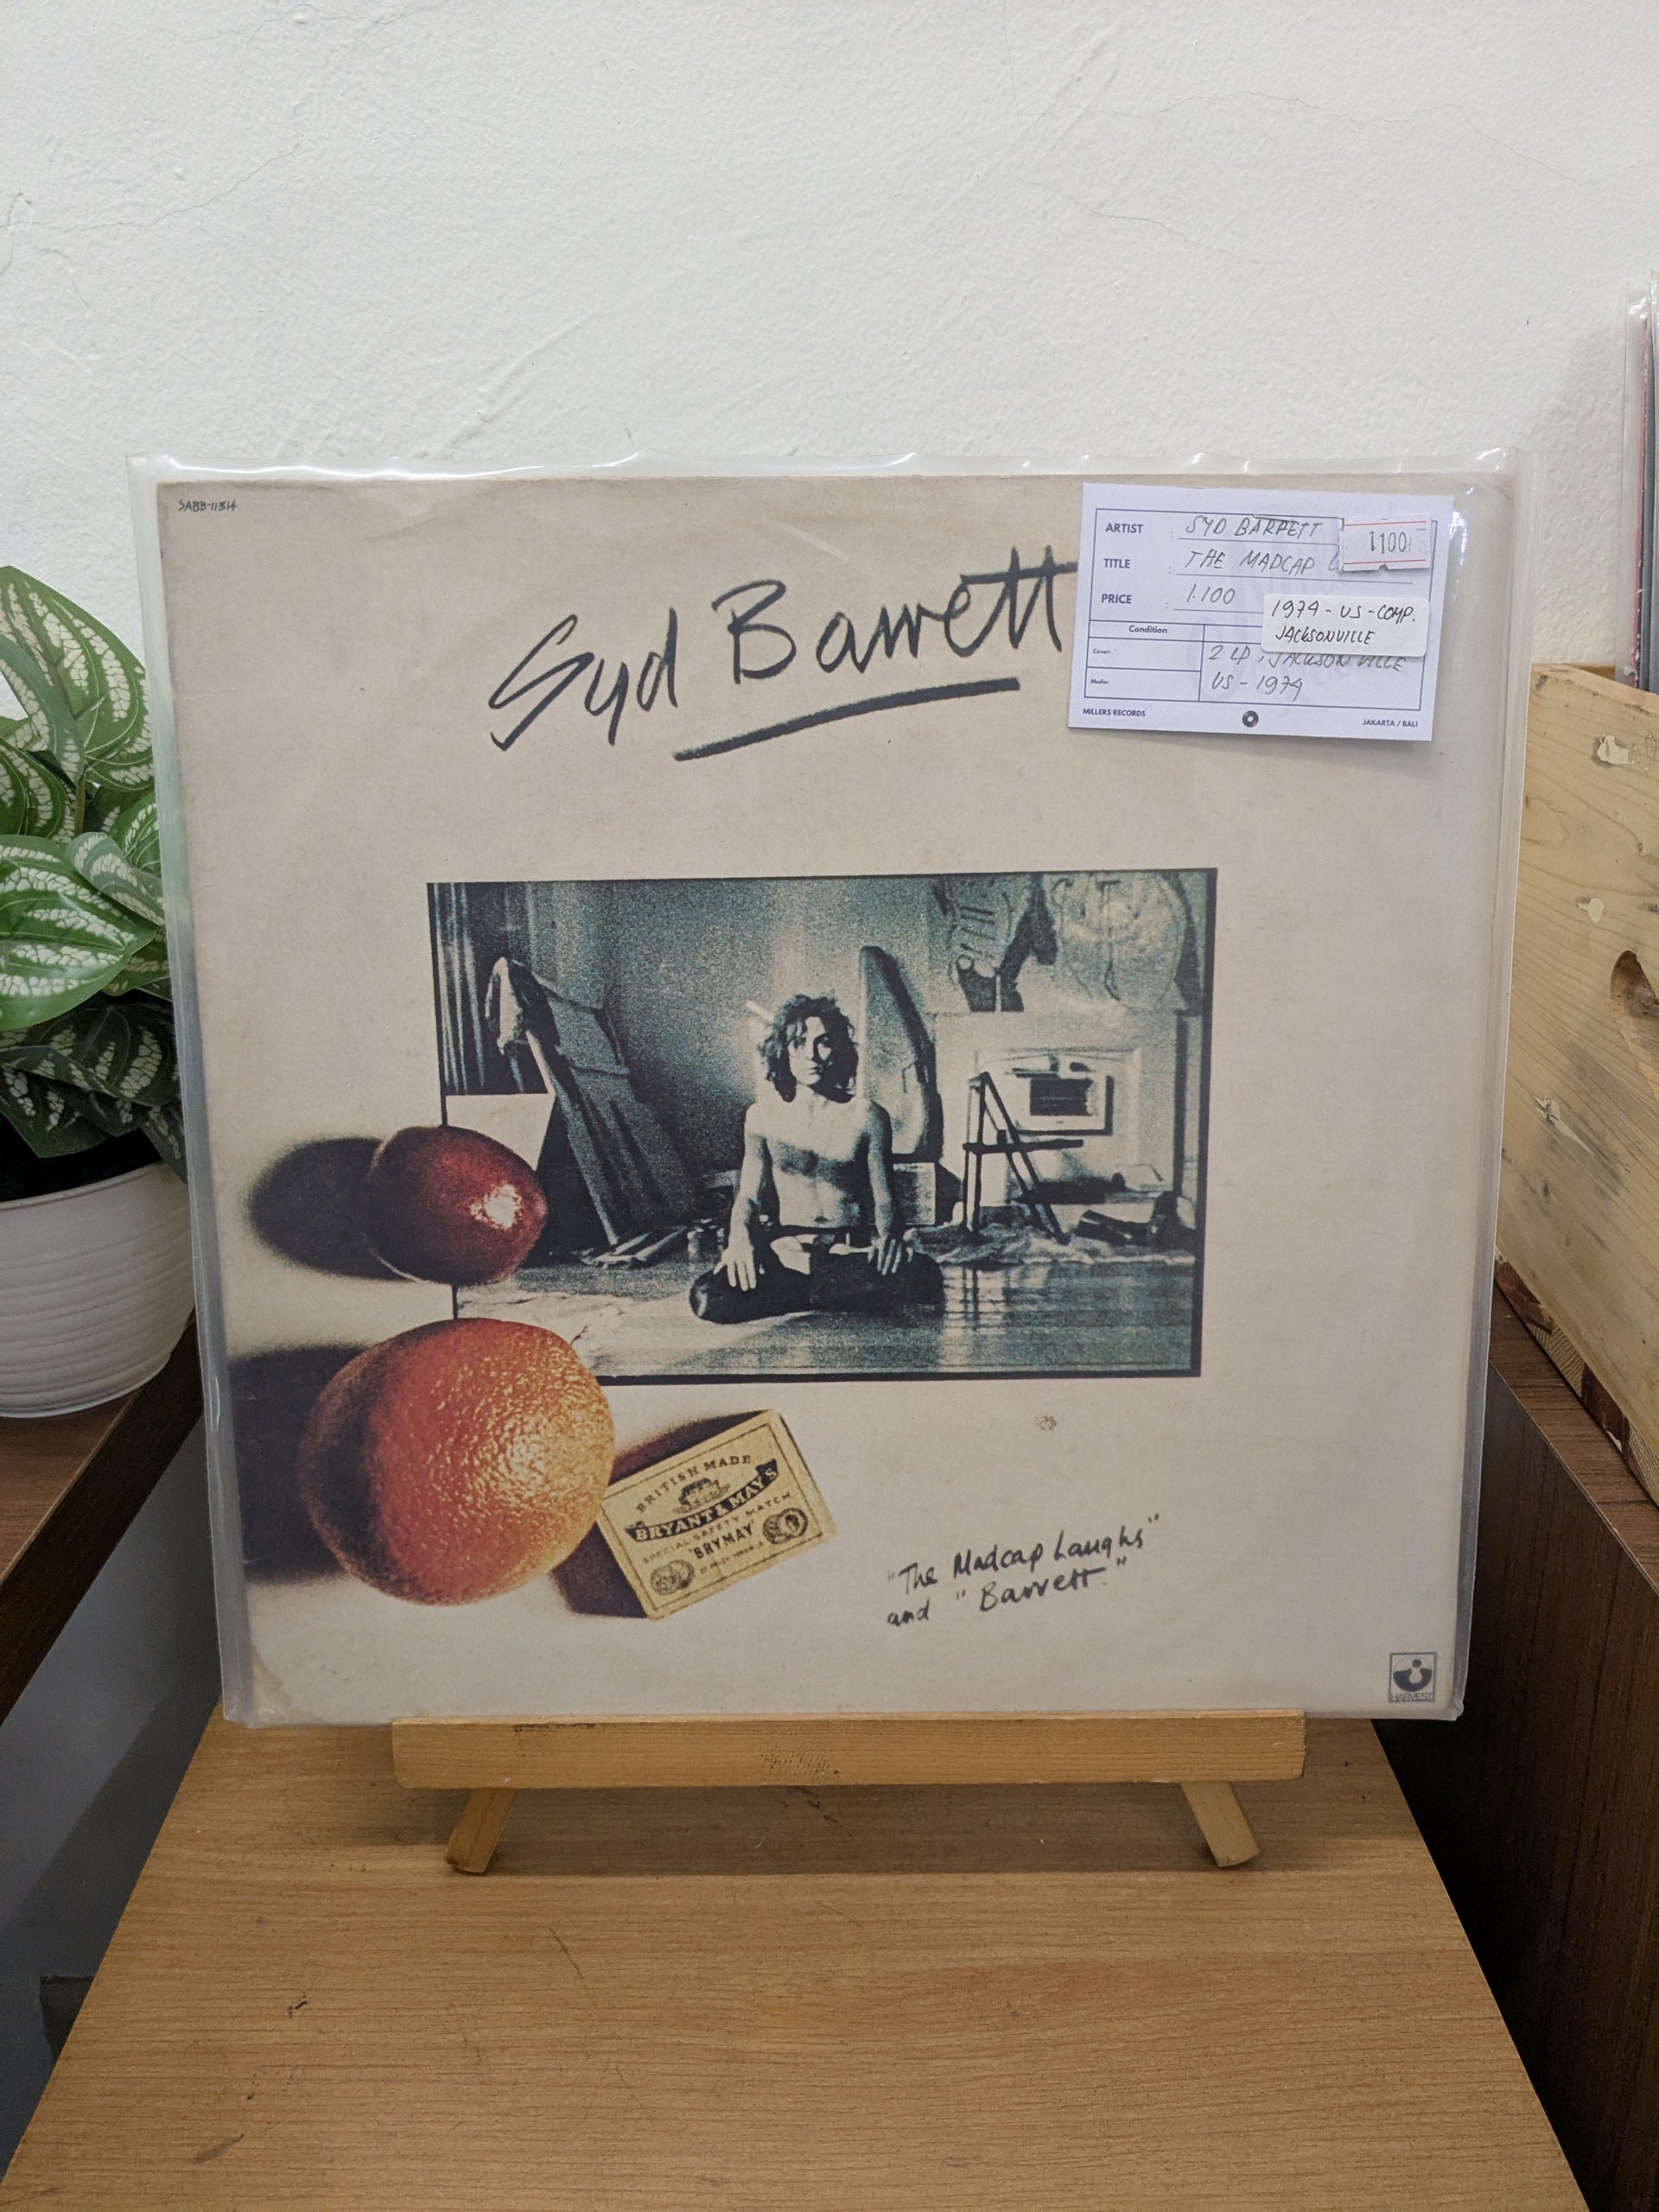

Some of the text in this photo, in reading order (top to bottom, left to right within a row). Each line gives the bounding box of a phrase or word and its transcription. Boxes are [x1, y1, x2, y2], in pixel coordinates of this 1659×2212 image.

[1105, 523, 1144, 534] ARTIST
[1185, 514, 1227, 535] SYD
[1103, 558, 1131, 569] TITLE
[1185, 549, 1227, 569] THE
[1239, 549, 1315, 577] MADCAP
[1101, 594, 1133, 605] PRICE
[1128, 625, 1168, 634] Condition
[1275, 624, 1376, 645] JACKSONVILLE
[488, 544, 1078, 752] Syd Barrett
[1209, 645, 1224, 661] 2
[1211, 671, 1235, 690] US
[1256, 676, 1303, 702] 1974
[1083, 708, 1146, 717] MILLERS RECORDS
[1362, 718, 1395, 727] JAKARTA
[636, 1455, 752, 1514] BRITISH MADE
[635, 1508, 715, 1541] BRYANT
[953, 1542, 1044, 1579] Madcap
[887, 1599, 930, 1627] and
